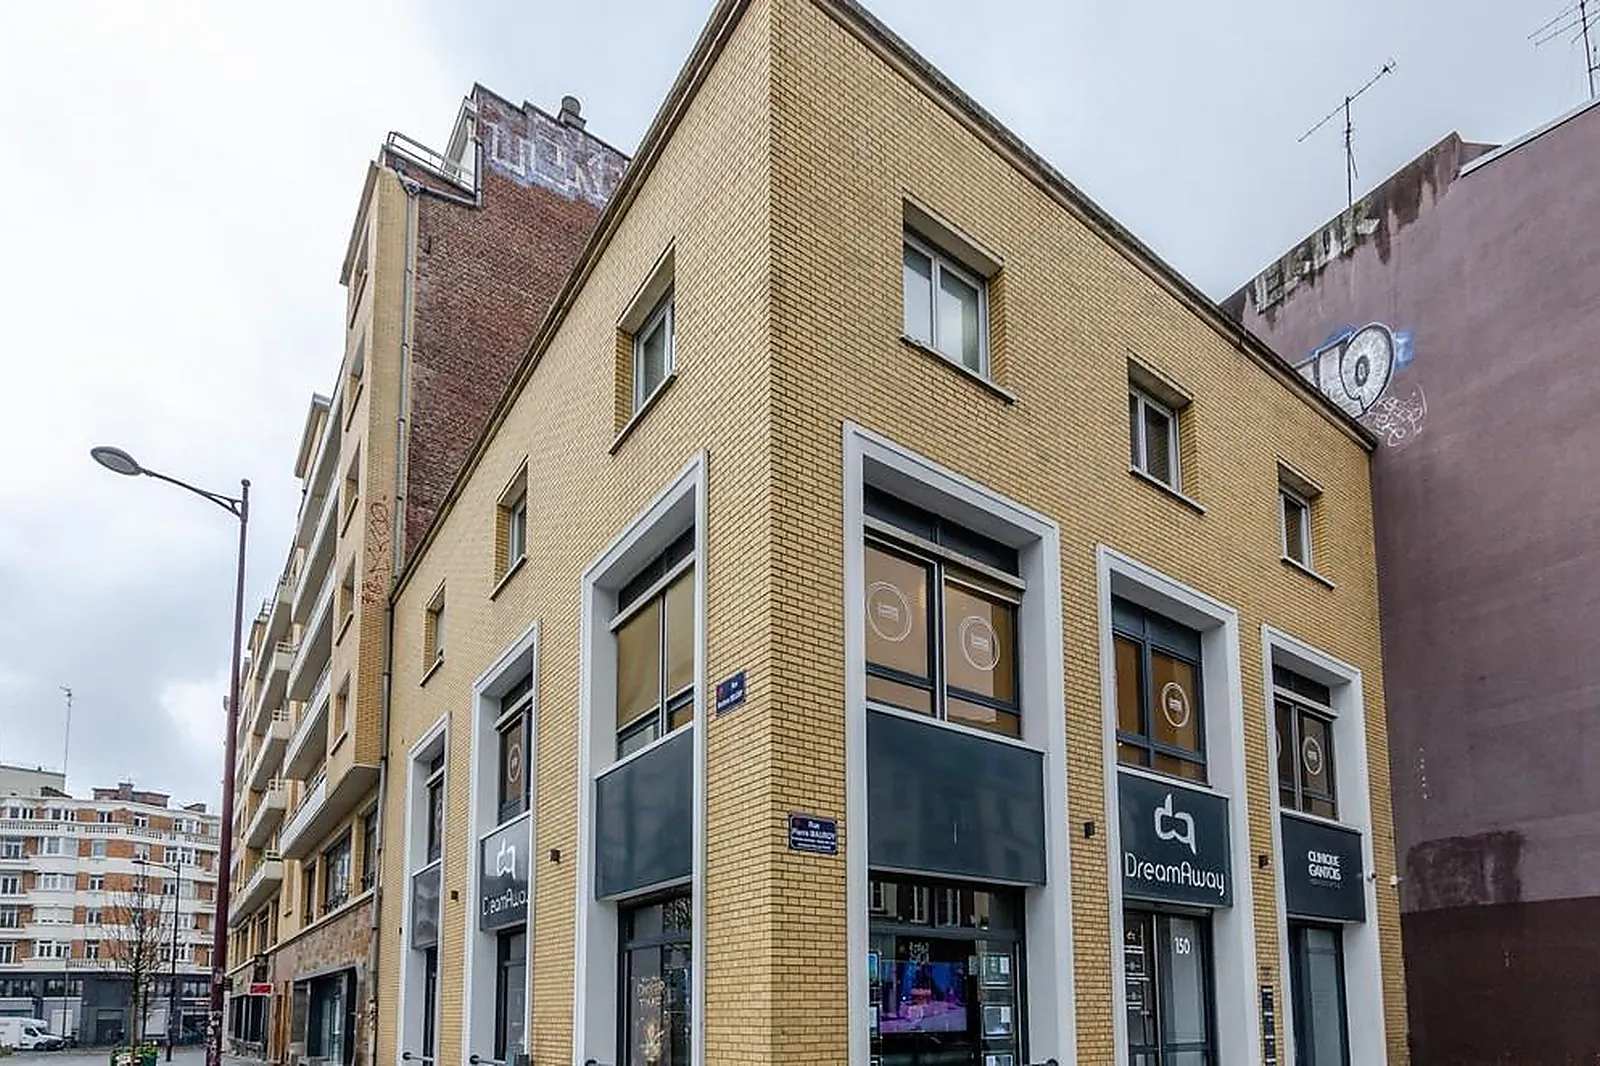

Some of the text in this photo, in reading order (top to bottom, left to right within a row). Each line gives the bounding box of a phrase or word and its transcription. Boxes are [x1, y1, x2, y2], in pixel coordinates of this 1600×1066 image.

[808, 821, 820, 830] Rue
[1124, 852, 1225, 896] DreamAway
[1174, 937, 1191, 955] 150
